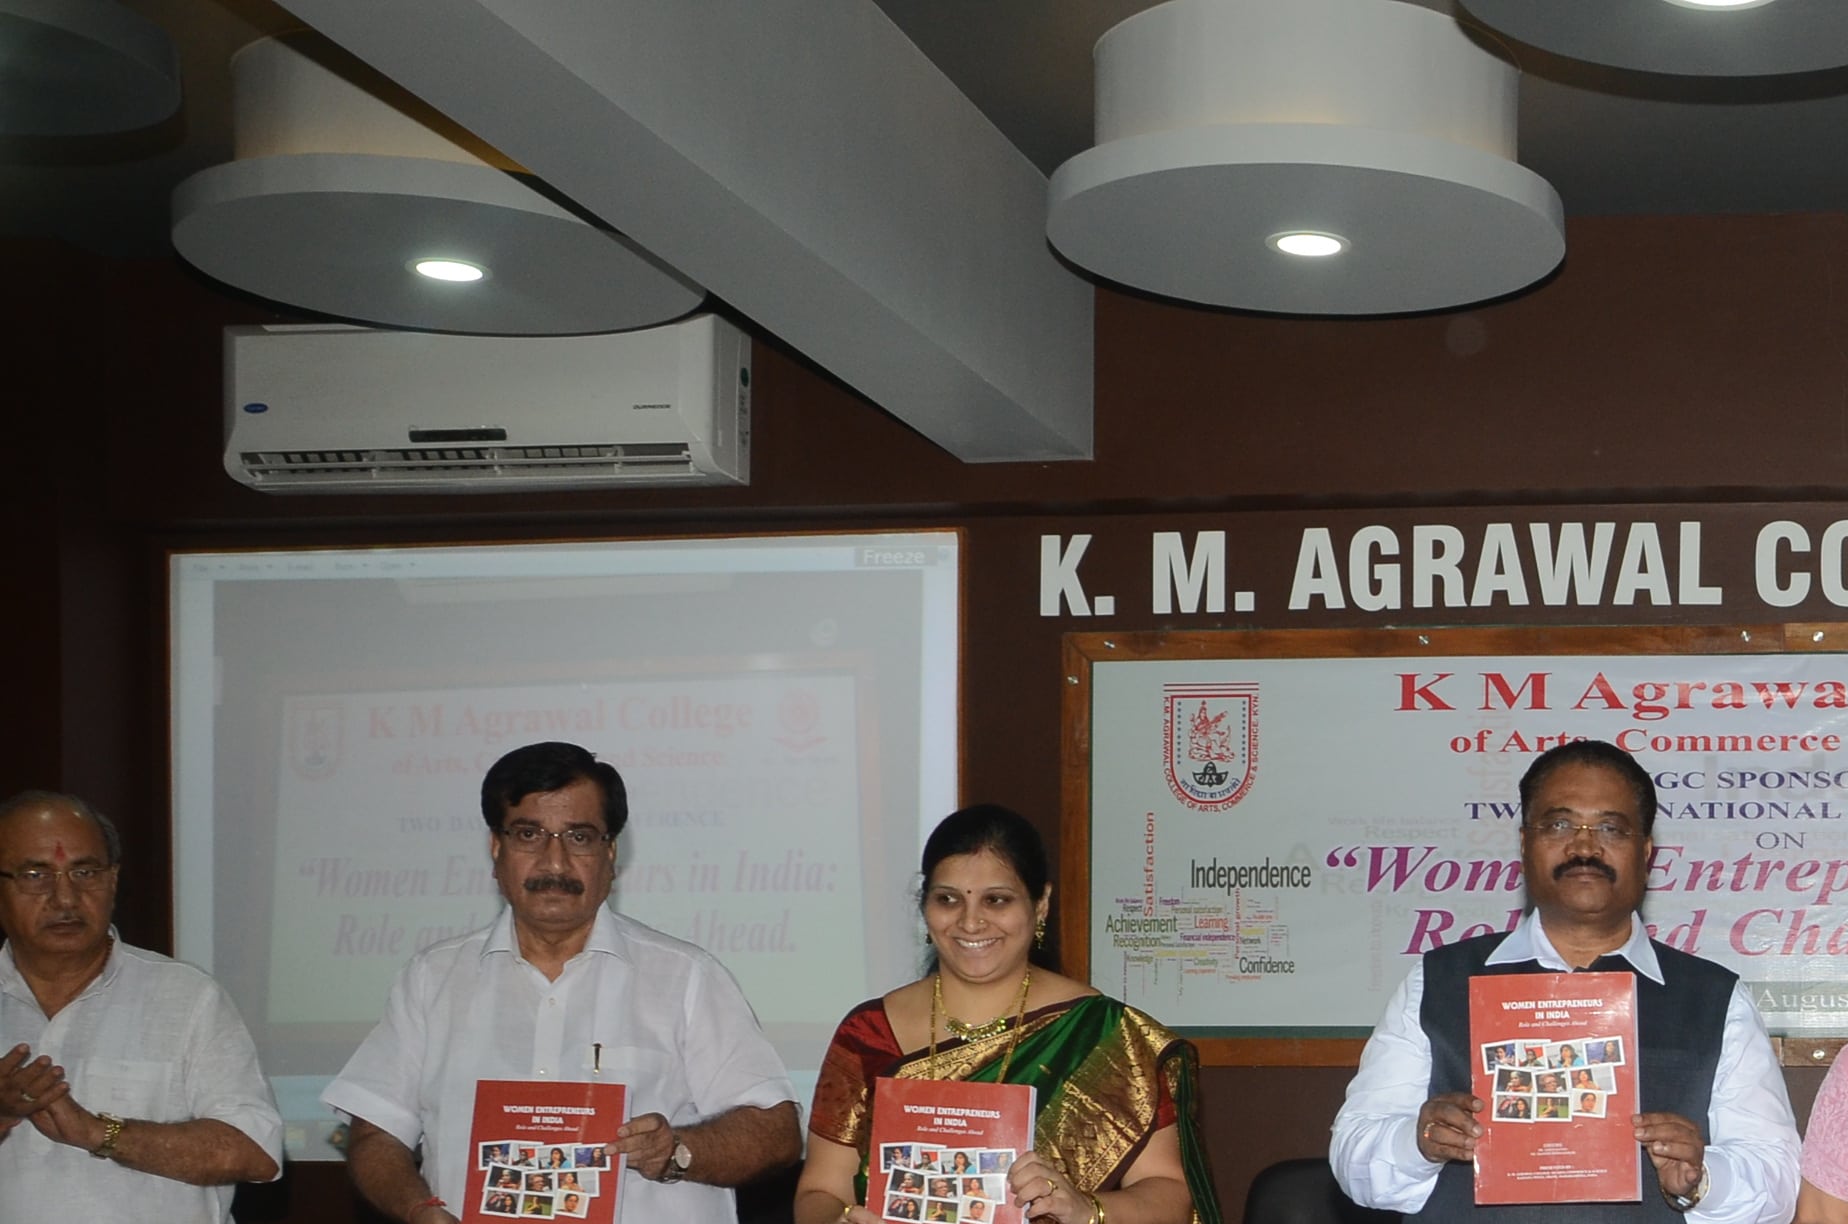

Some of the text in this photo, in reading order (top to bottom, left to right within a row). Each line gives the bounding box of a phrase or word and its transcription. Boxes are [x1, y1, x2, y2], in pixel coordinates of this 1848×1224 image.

[863, 549, 925, 565] Freeze
[1040, 534, 1115, 616] K.
[1152, 531, 1255, 614] M.
[1289, 521, 1723, 610] AGRAWAL
[1394, 672, 1456, 711] K
[1478, 671, 1552, 711] M
[369, 695, 754, 743] K M Agrawal College
[1449, 728, 1493, 754] of
[1615, 728, 1841, 753] Commerce
[1464, 802, 1522, 820] TW
[1755, 831, 1806, 851] ON
[734, 848, 838, 894] India:
[1143, 811, 1155, 917] Satisfaction
[1191, 857, 1312, 897] Independence
[1105, 913, 1178, 933] Achievement
[1194, 914, 1229, 931] Learning
[334, 912, 406, 957] Role
[1239, 956, 1295, 974] Confidence
[1502, 998, 1604, 1011] WOMEN ENTREPRENEURS
[1535, 1010, 1570, 1020] IN INDIA
[903, 1104, 936, 1115] WOMEN
[933, 1117, 967, 1127] IN INDIA
